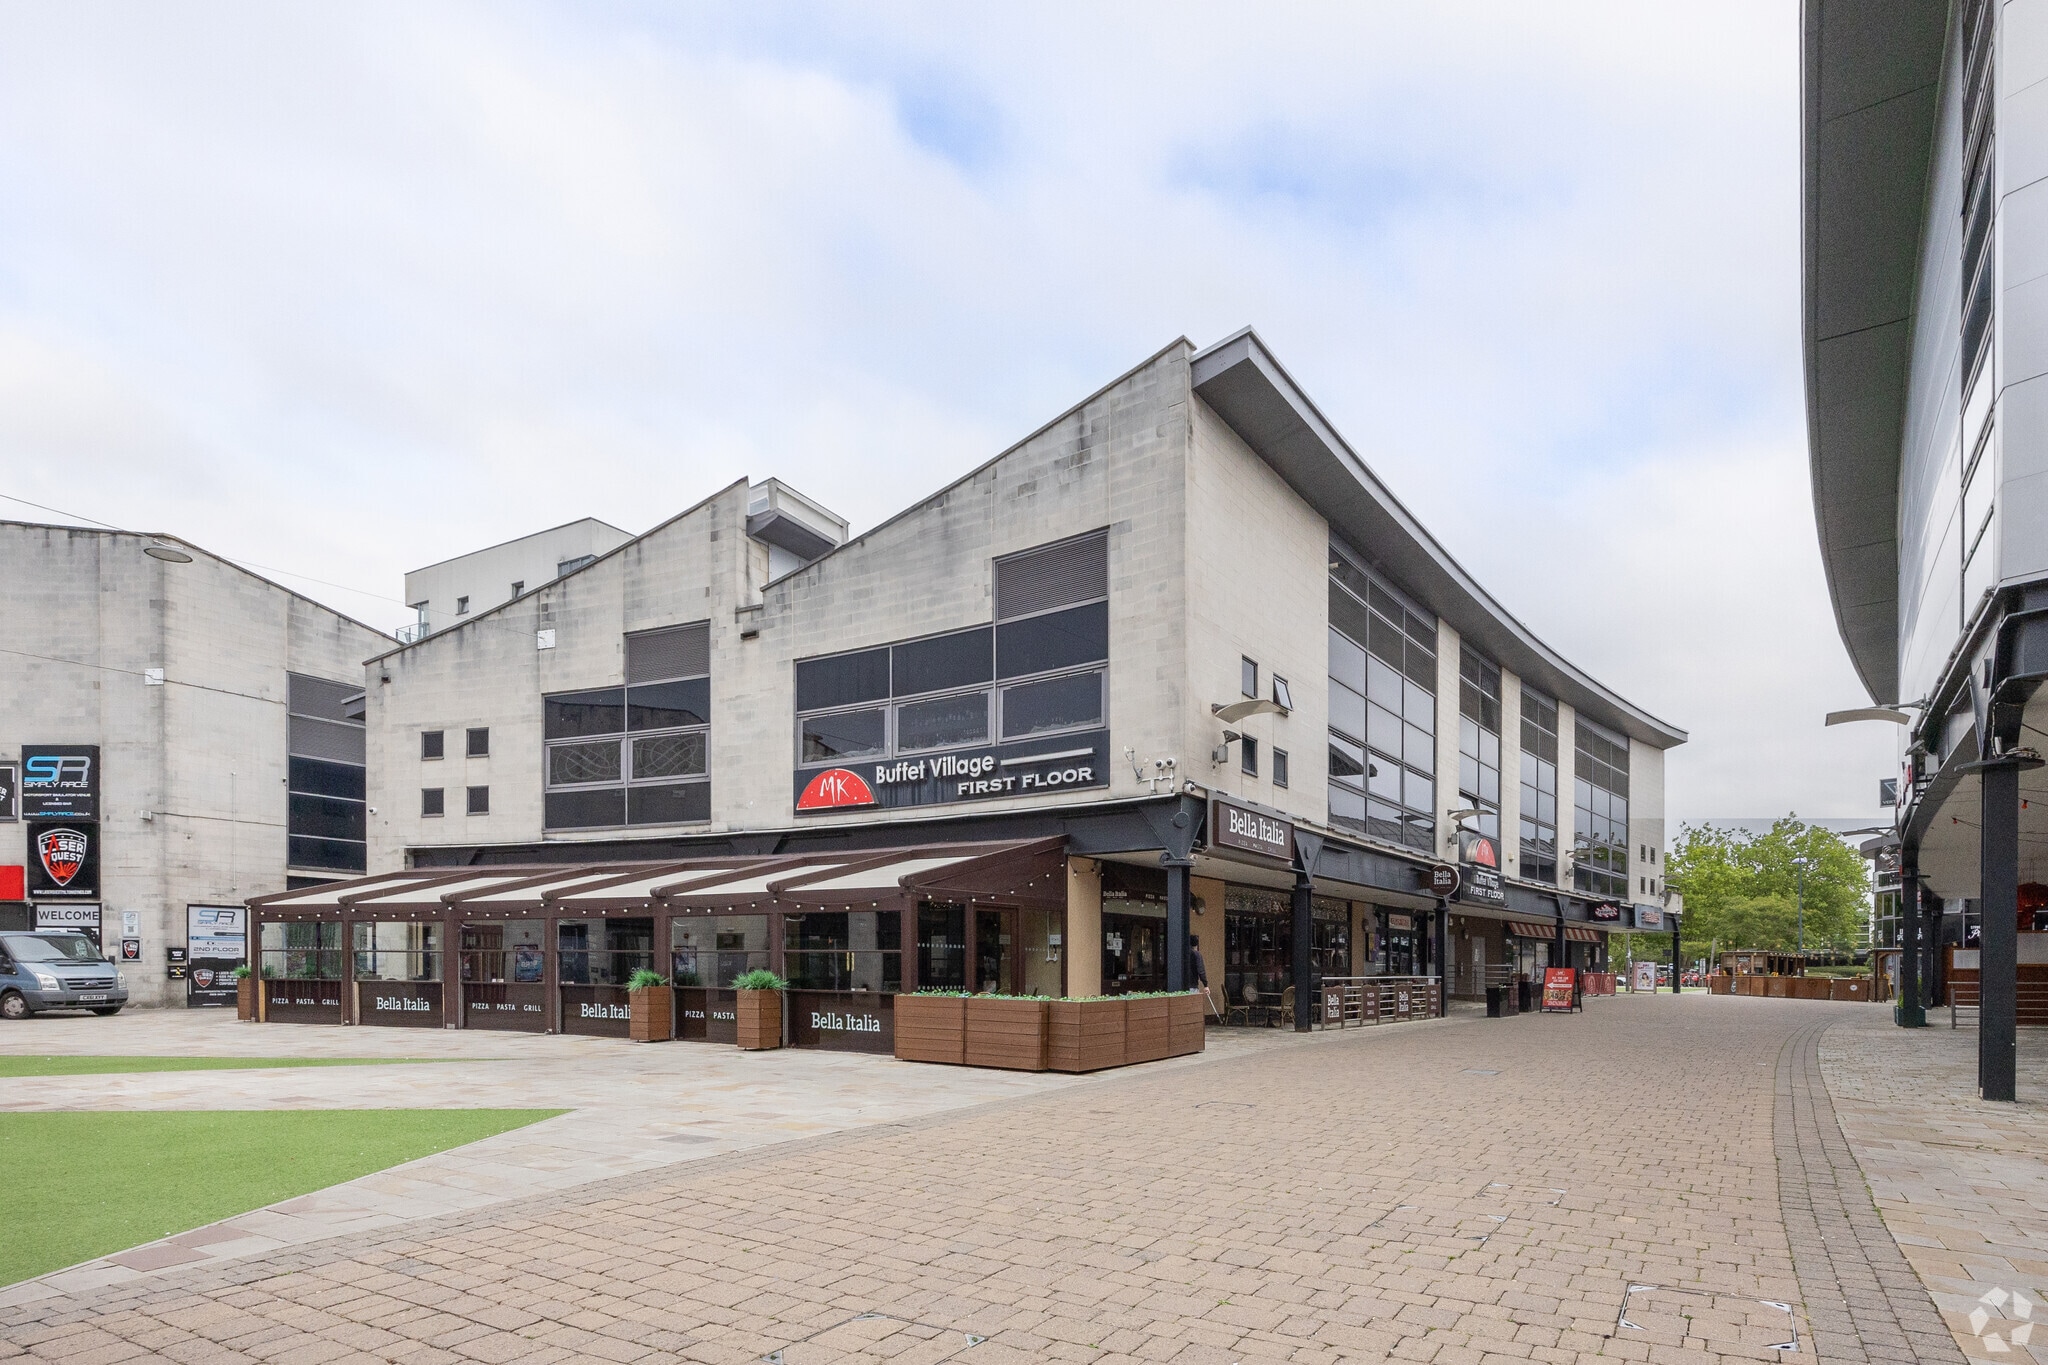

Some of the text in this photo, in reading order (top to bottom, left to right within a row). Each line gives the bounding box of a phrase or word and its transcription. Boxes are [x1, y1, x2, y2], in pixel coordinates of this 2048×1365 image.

[24, 756, 91, 782] SR
[876, 755, 994, 784] Buffet Village
[957, 767, 1094, 796] FIRST FLOOR
[820, 776, 850, 804] MK
[1229, 809, 1284, 846] Bella Italia
[41, 834, 84, 861] LASER
[51, 851, 82, 862] QUEST
[1433, 877, 1452, 885] Italia
[1434, 870, 1451, 878] Bella
[1470, 886, 1504, 900] FIRST FLOOR
[38, 911, 99, 920] WELCOME
[198, 910, 236, 923] SR
[376, 996, 430, 1011] Bella Italia
[472, 1002, 542, 1012] PIZZA PASTA GRILL
[581, 1003, 631, 1020] Bella Itali
[685, 1010, 735, 1020] PIZZA PASTA
[811, 1012, 881, 1032] Bella Italia
